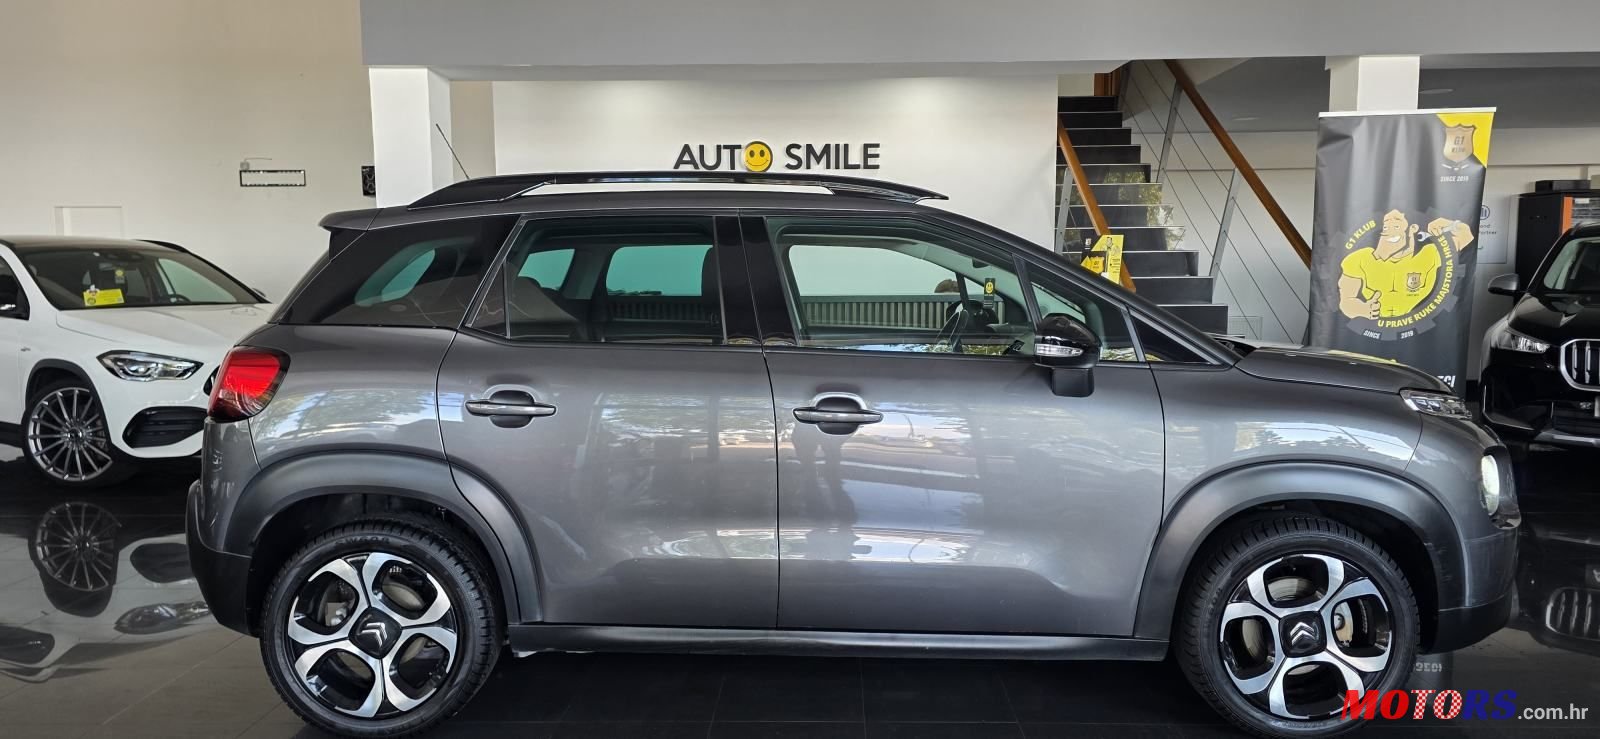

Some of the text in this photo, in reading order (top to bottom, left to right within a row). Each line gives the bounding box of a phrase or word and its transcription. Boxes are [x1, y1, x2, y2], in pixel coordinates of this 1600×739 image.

[785, 143, 880, 170] SMILE
[1345, 220, 1376, 250] G1 KLUB
[1385, 316, 1414, 328] PRAVE
[1414, 303, 1437, 321] RUKE
[1434, 259, 1454, 305] MAJSTORA
[1363, 330, 1414, 340] SINCE 2019
